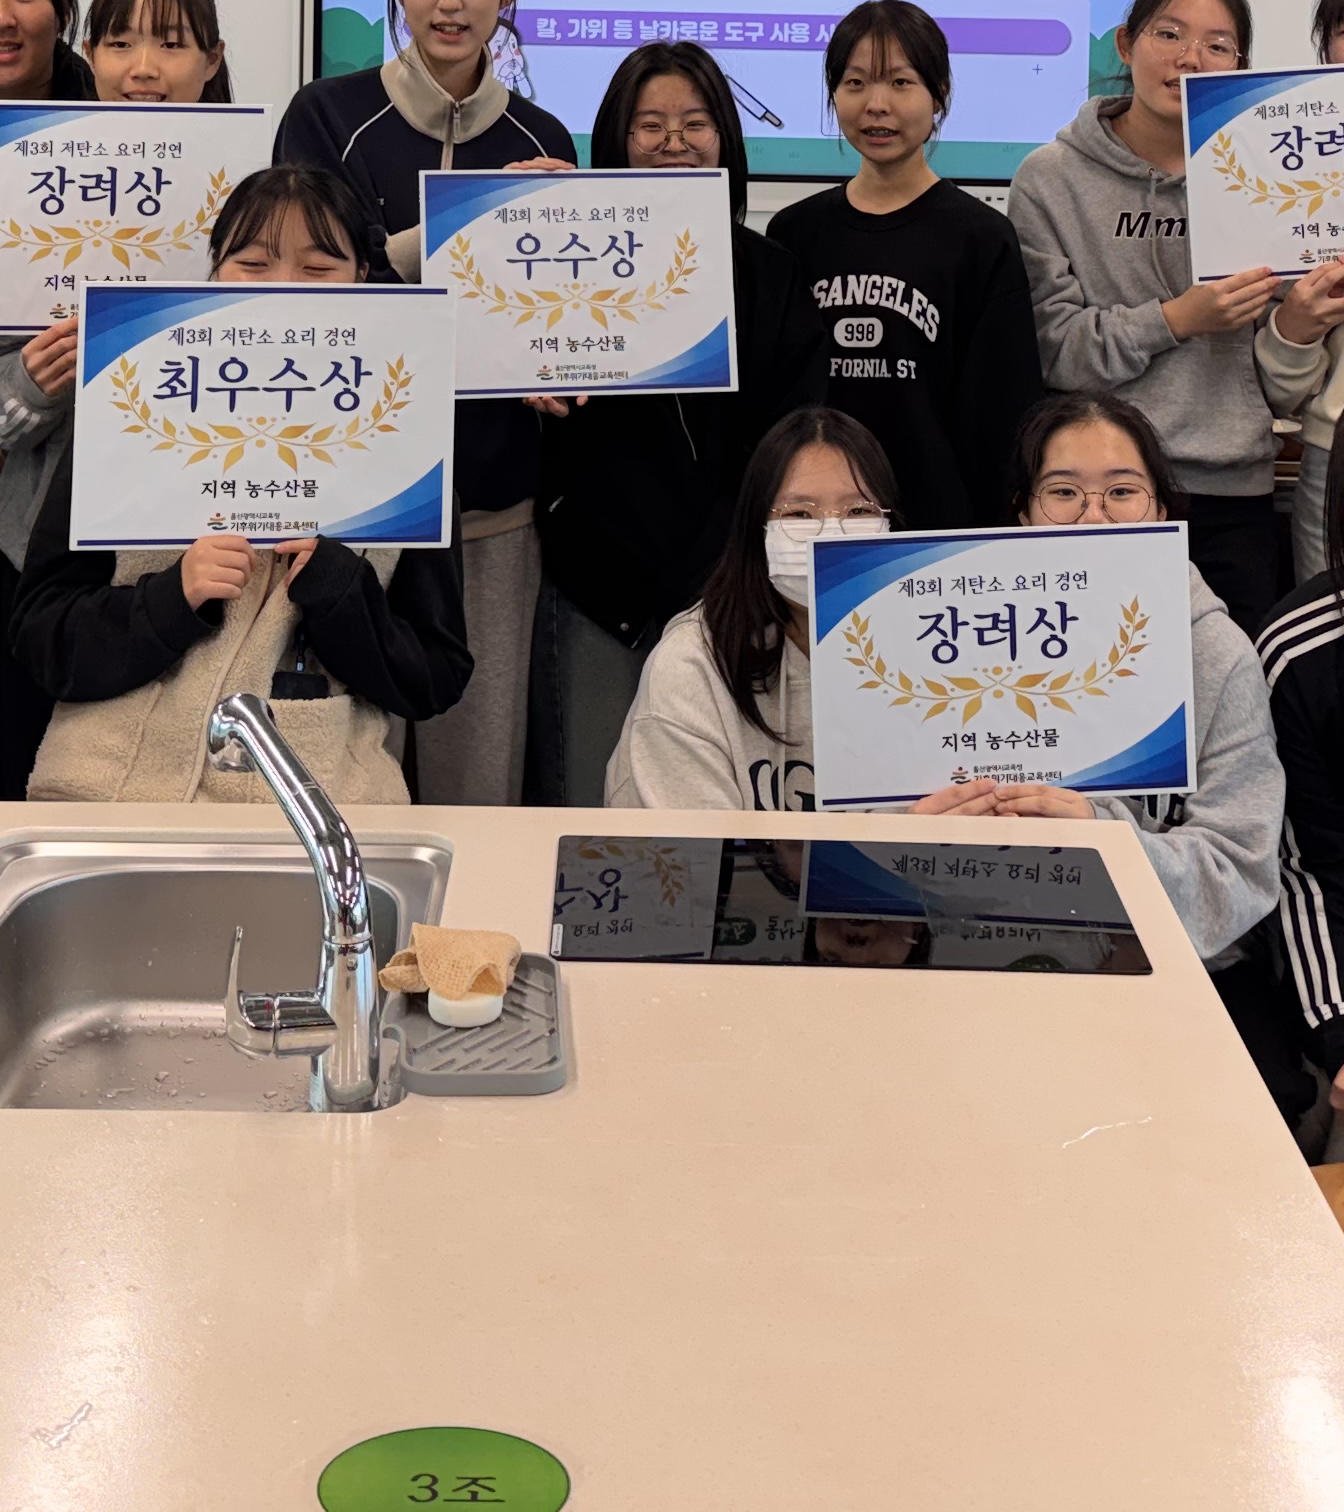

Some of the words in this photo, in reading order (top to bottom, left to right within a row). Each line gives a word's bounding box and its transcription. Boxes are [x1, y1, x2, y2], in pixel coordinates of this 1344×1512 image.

[536, 17, 562, 41] 칼,
[567, 18, 608, 40] 가위
[613, 19, 633, 39] 등
[639, 20, 720, 41] 날카로운
[724, 21, 764, 42] 도구
[769, 22, 810, 43] 사용
[1253, 103, 1289, 121] 제3회
[13, 140, 54, 158] 제3회
[60, 141, 109, 158] 저탄소
[115, 141, 146, 158] 요리
[152, 141, 182, 160] 경연
[27, 166, 172, 217] 장려상
[494, 207, 531, 224] 제3회
[537, 208, 581, 223] 저탄소
[588, 207, 616, 223] 요리
[622, 206, 650, 223] 경연
[1292, 222, 1320, 239] 지역
[506, 230, 644, 281] 우수상
[44, 274, 75, 291] 지역
[168, 327, 213, 346] 제3회
[220, 327, 275, 346] 저탄소
[281, 327, 316, 347] 요리
[323, 327, 357, 347] 경연
[530, 337, 559, 353] 지역
[566, 336, 626, 353] 농수산물
[152, 355, 374, 414] 최우수상
[201, 479, 236, 499] 지역
[244, 479, 319, 499] 농수산물
[898, 576, 942, 598] 제3회
[951, 575, 1005, 596] 저탄소
[1012, 572, 1047, 593] 요리
[1054, 570, 1088, 591] 경연
[916, 601, 1079, 664] 장려상
[942, 733, 976, 752] 지역
[986, 728, 1060, 750] 농수산물
[407, 1473, 506, 1503] 3조
